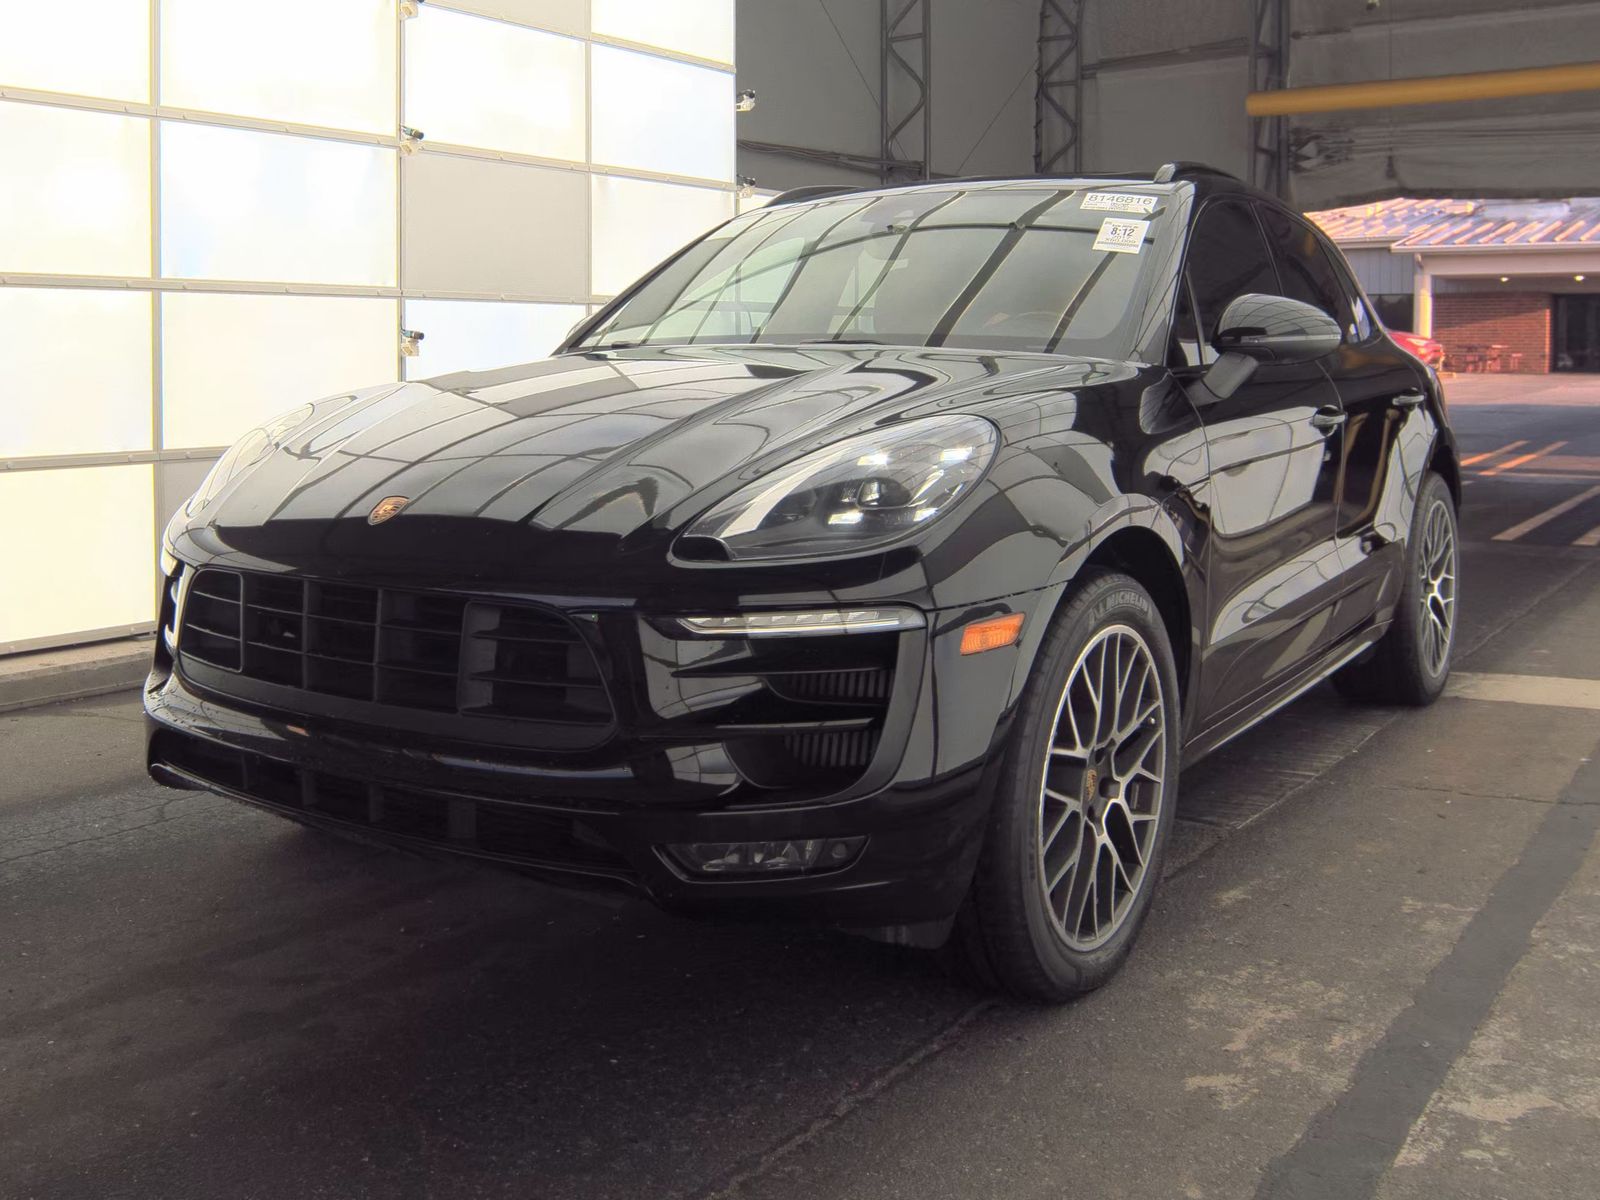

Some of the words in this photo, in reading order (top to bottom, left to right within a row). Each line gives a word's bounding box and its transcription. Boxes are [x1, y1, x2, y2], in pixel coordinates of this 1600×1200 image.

[1088, 194, 1153, 205] 8146816
[1110, 227, 1135, 237] 8:12
[1106, 591, 1148, 612] MICHELIN
